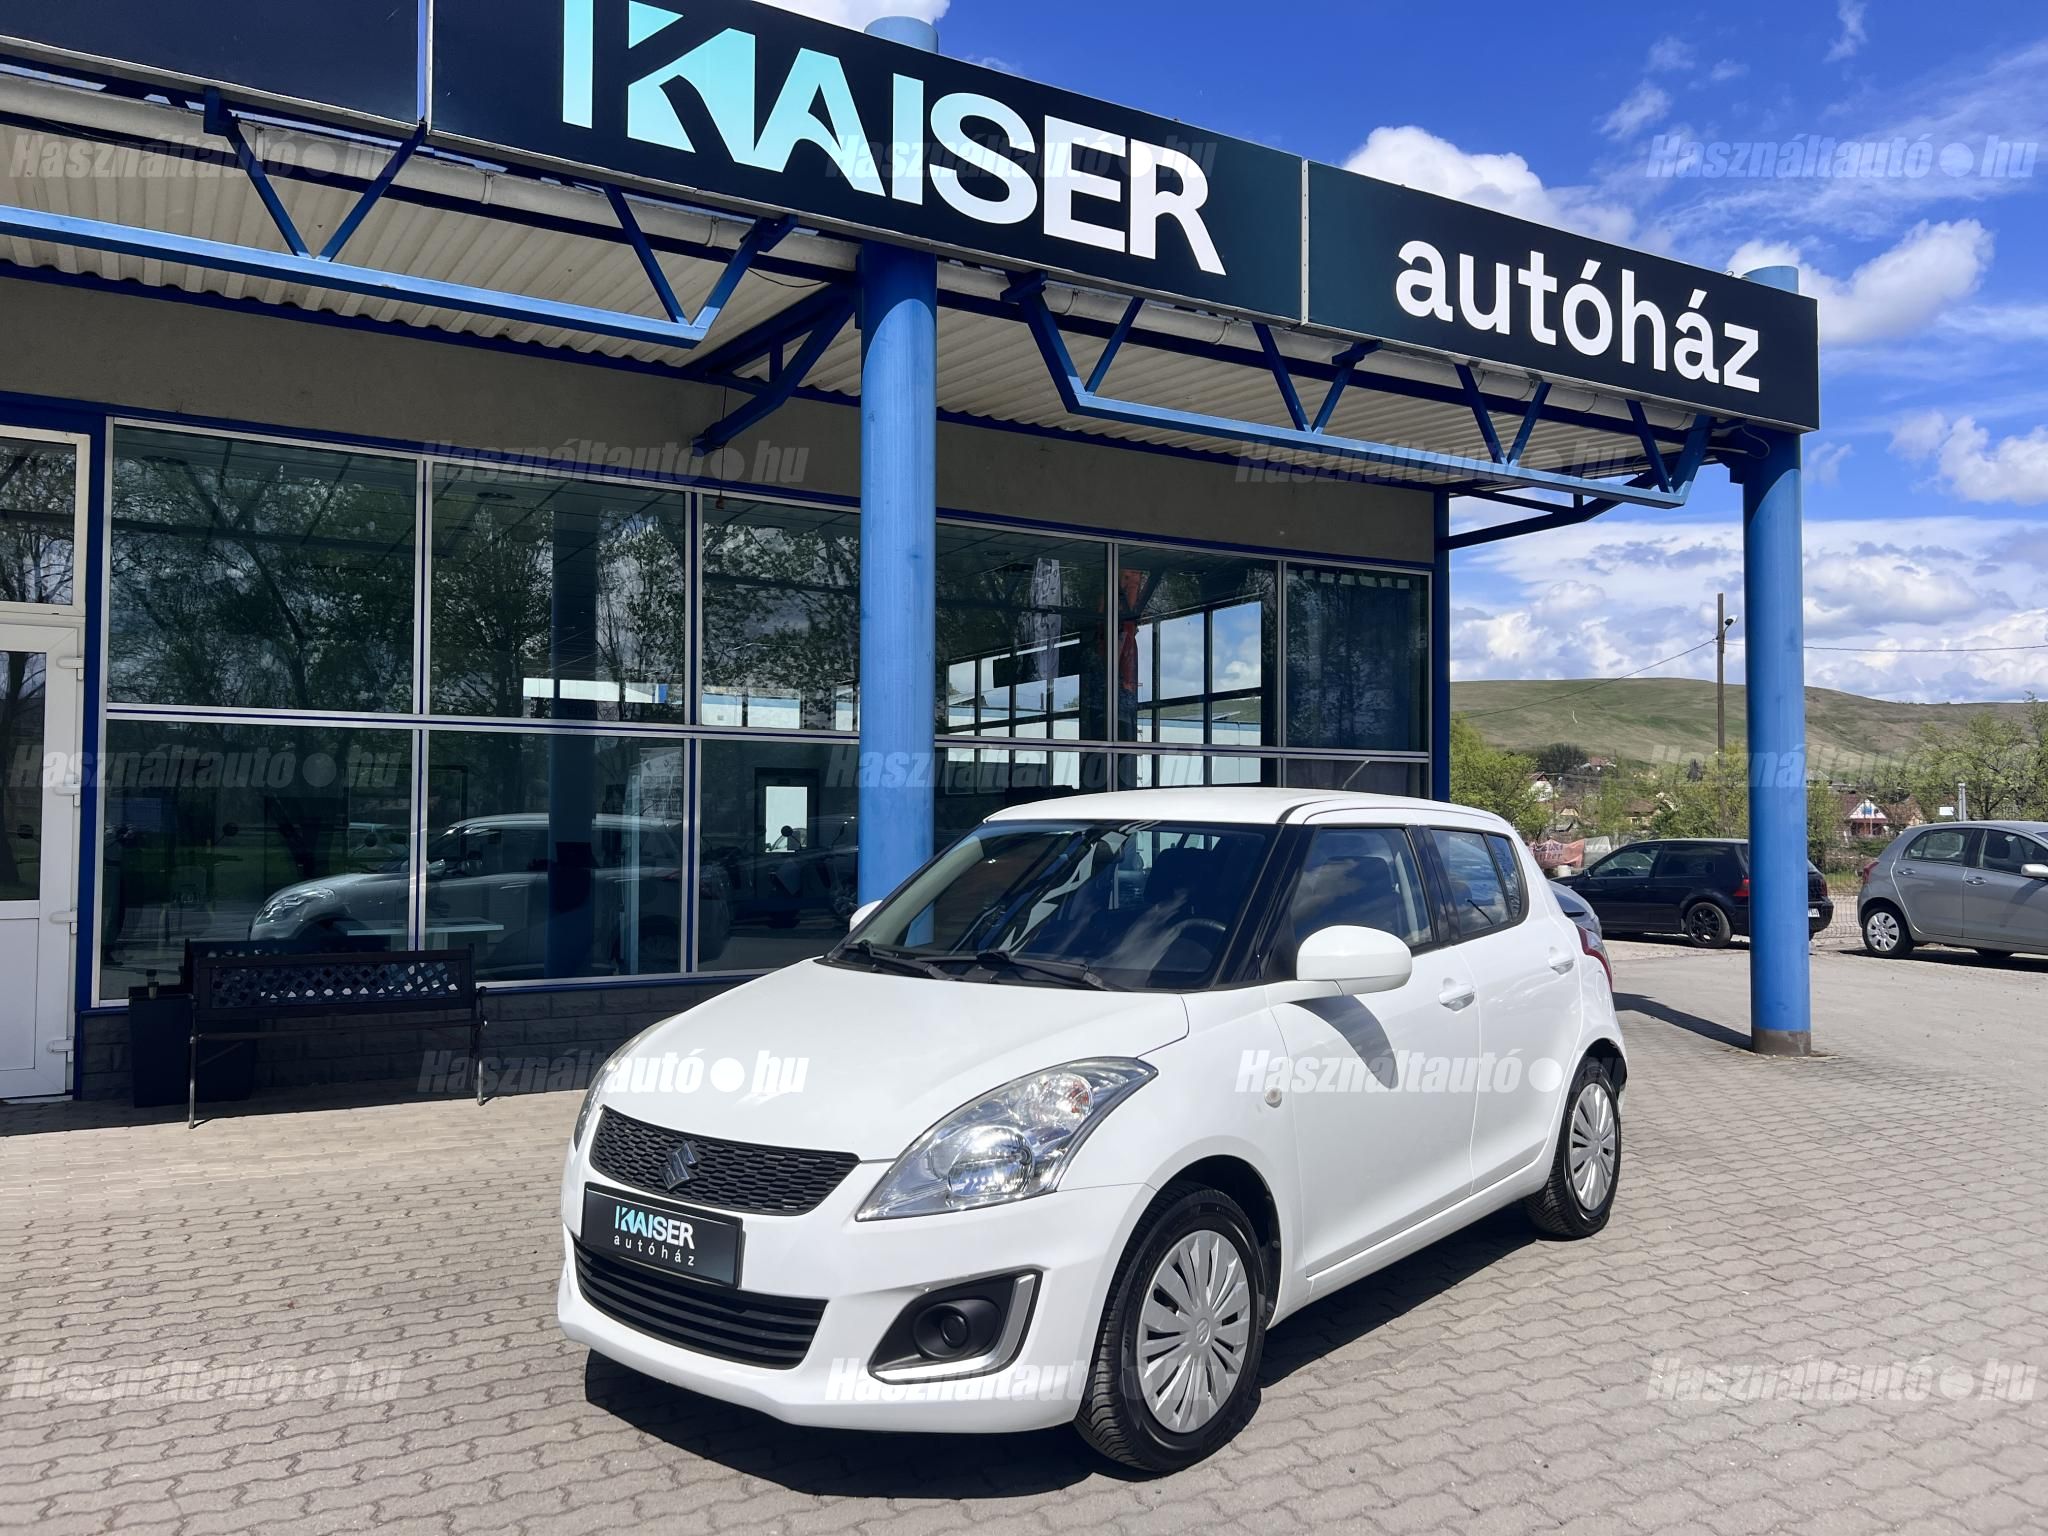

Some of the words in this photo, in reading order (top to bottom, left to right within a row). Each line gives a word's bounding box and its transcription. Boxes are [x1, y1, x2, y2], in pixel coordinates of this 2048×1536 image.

[562, 0, 1227, 276] KAISER
[1395, 240, 1761, 393] autóház
[614, 1205, 695, 1250] KAISER
[613, 1235, 695, 1266] autóház
